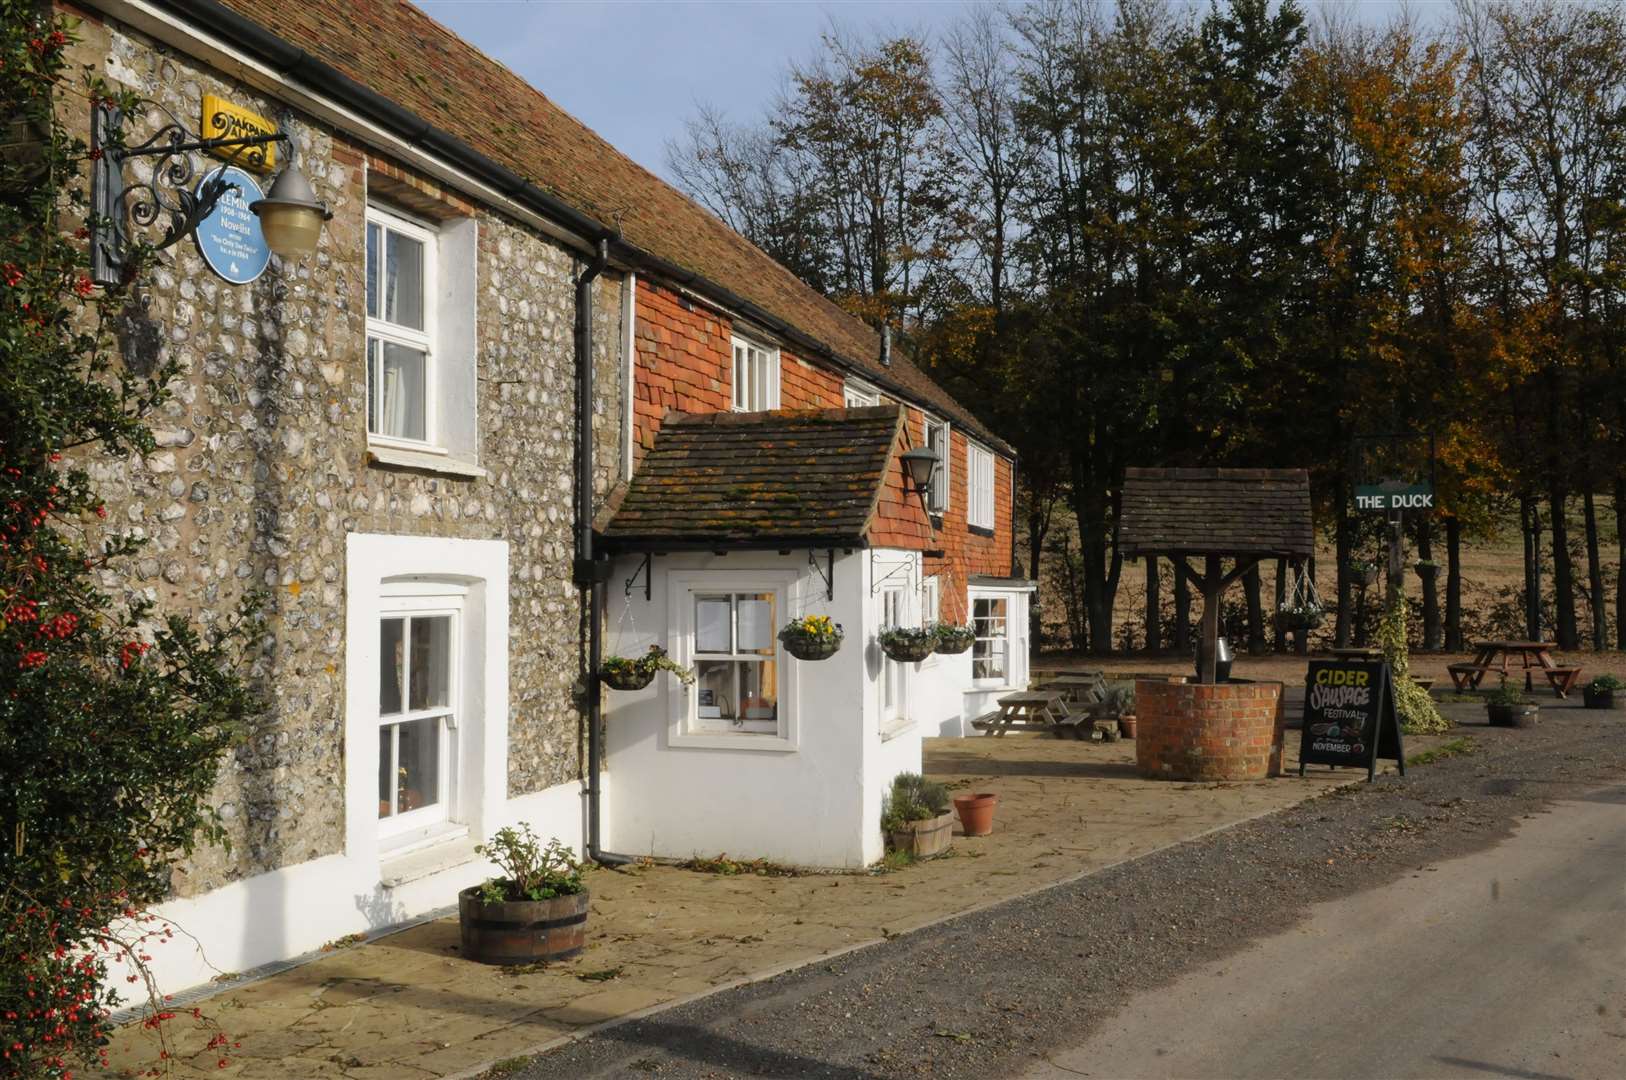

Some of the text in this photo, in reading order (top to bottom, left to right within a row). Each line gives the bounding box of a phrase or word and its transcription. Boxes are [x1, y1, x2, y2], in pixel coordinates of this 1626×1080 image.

[217, 193, 254, 214] LEMIN
[221, 216, 251, 235] Novelist
[1356, 494, 1433, 508] THE DUCK
[1316, 668, 1369, 686] CIDER
[1310, 683, 1370, 710] SAUSAGE
[1323, 708, 1363, 719] FESTIVAL
[1312, 742, 1351, 752] NOVEMBER
